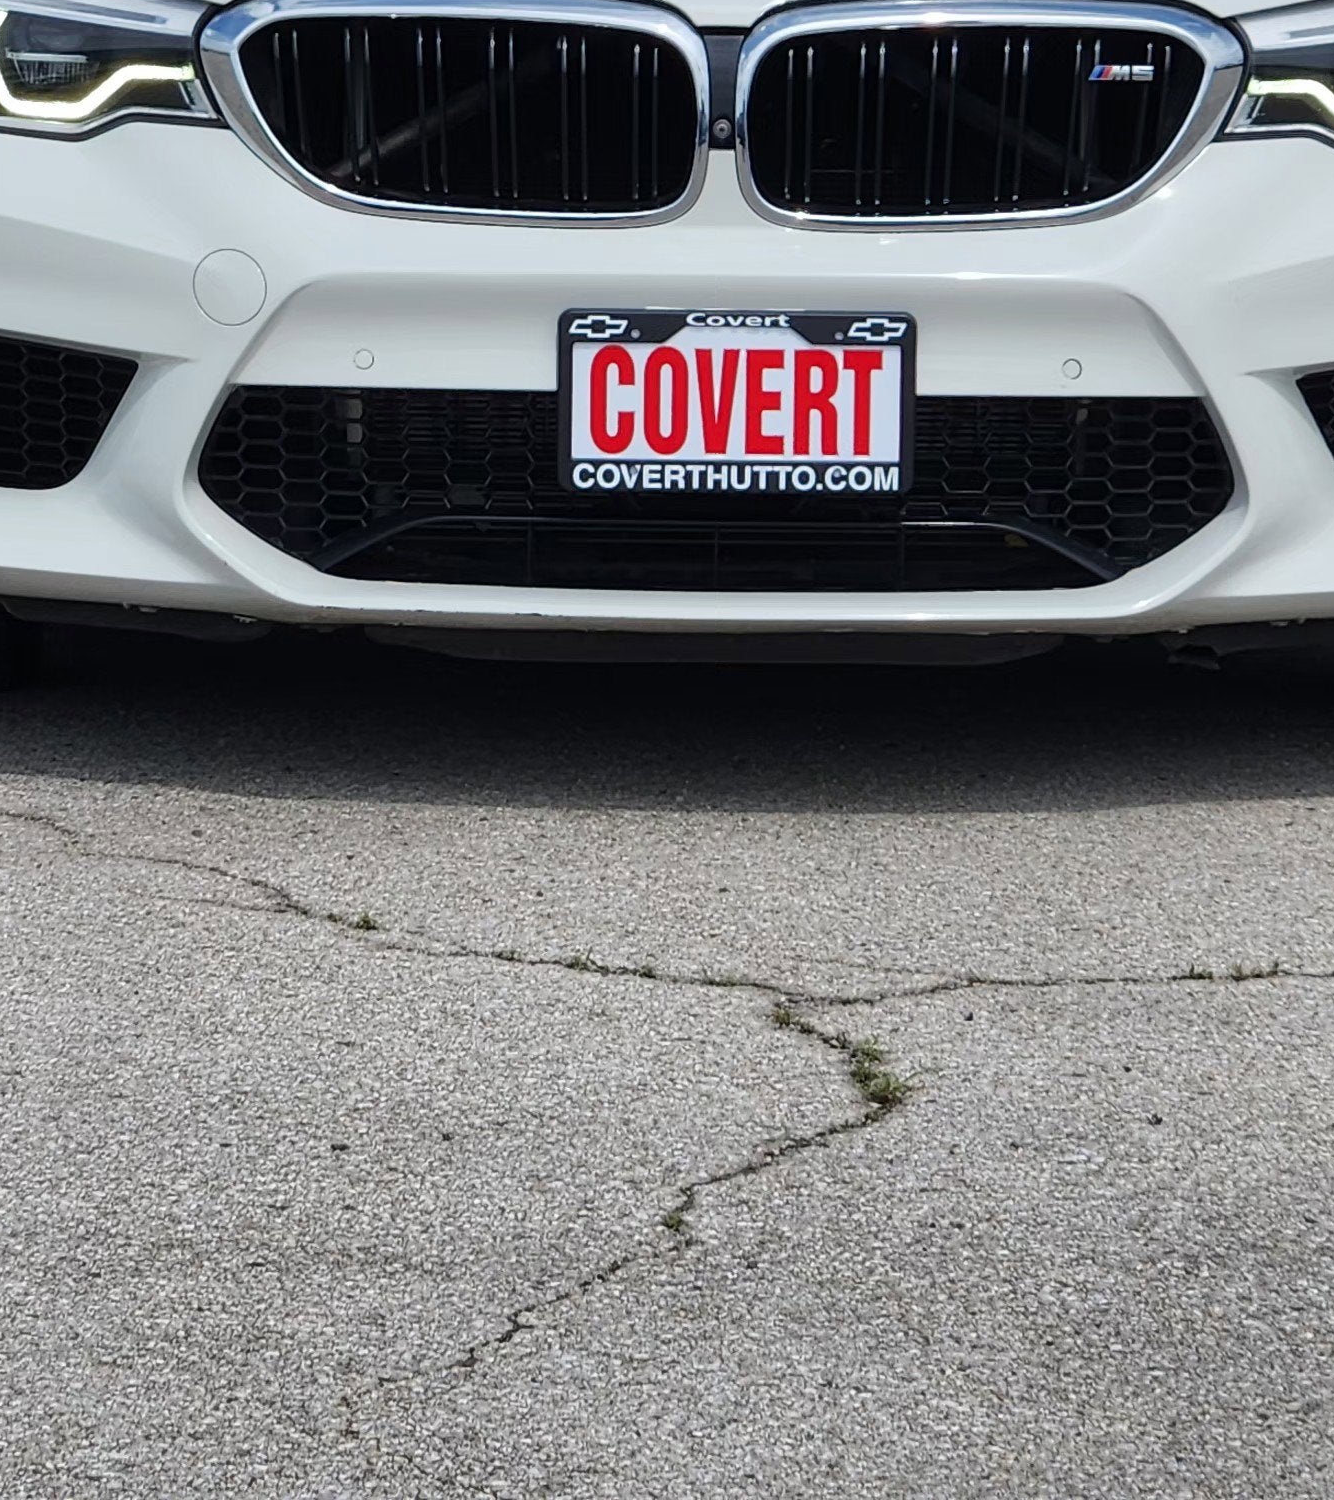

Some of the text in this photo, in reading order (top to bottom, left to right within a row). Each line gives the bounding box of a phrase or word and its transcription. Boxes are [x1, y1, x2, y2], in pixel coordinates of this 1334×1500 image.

[1111, 64, 1155, 81] M5
[685, 312, 791, 328] Covert
[589, 344, 884, 456] COVERT
[571, 462, 900, 492] COVERTHUTTO.COM
